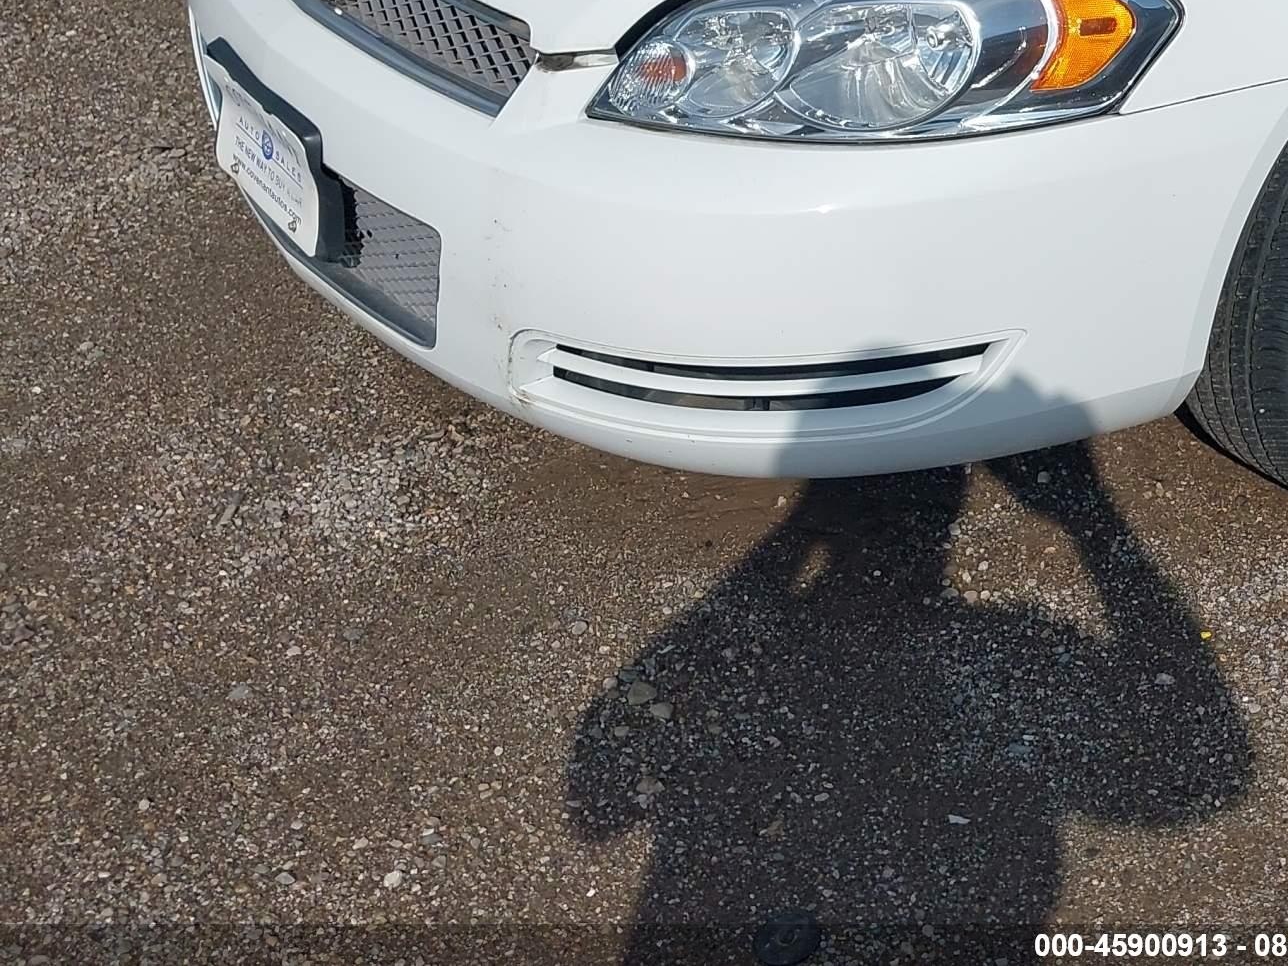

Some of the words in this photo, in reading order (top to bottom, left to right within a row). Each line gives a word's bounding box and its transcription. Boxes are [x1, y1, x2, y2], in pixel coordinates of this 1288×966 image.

[234, 136, 245, 153] THE
[244, 146, 256, 163] NEW
[255, 155, 268, 174] WAY
[267, 165, 275, 181] TO
[239, 117, 260, 140] AUTO
[275, 151, 302, 182] SALES
